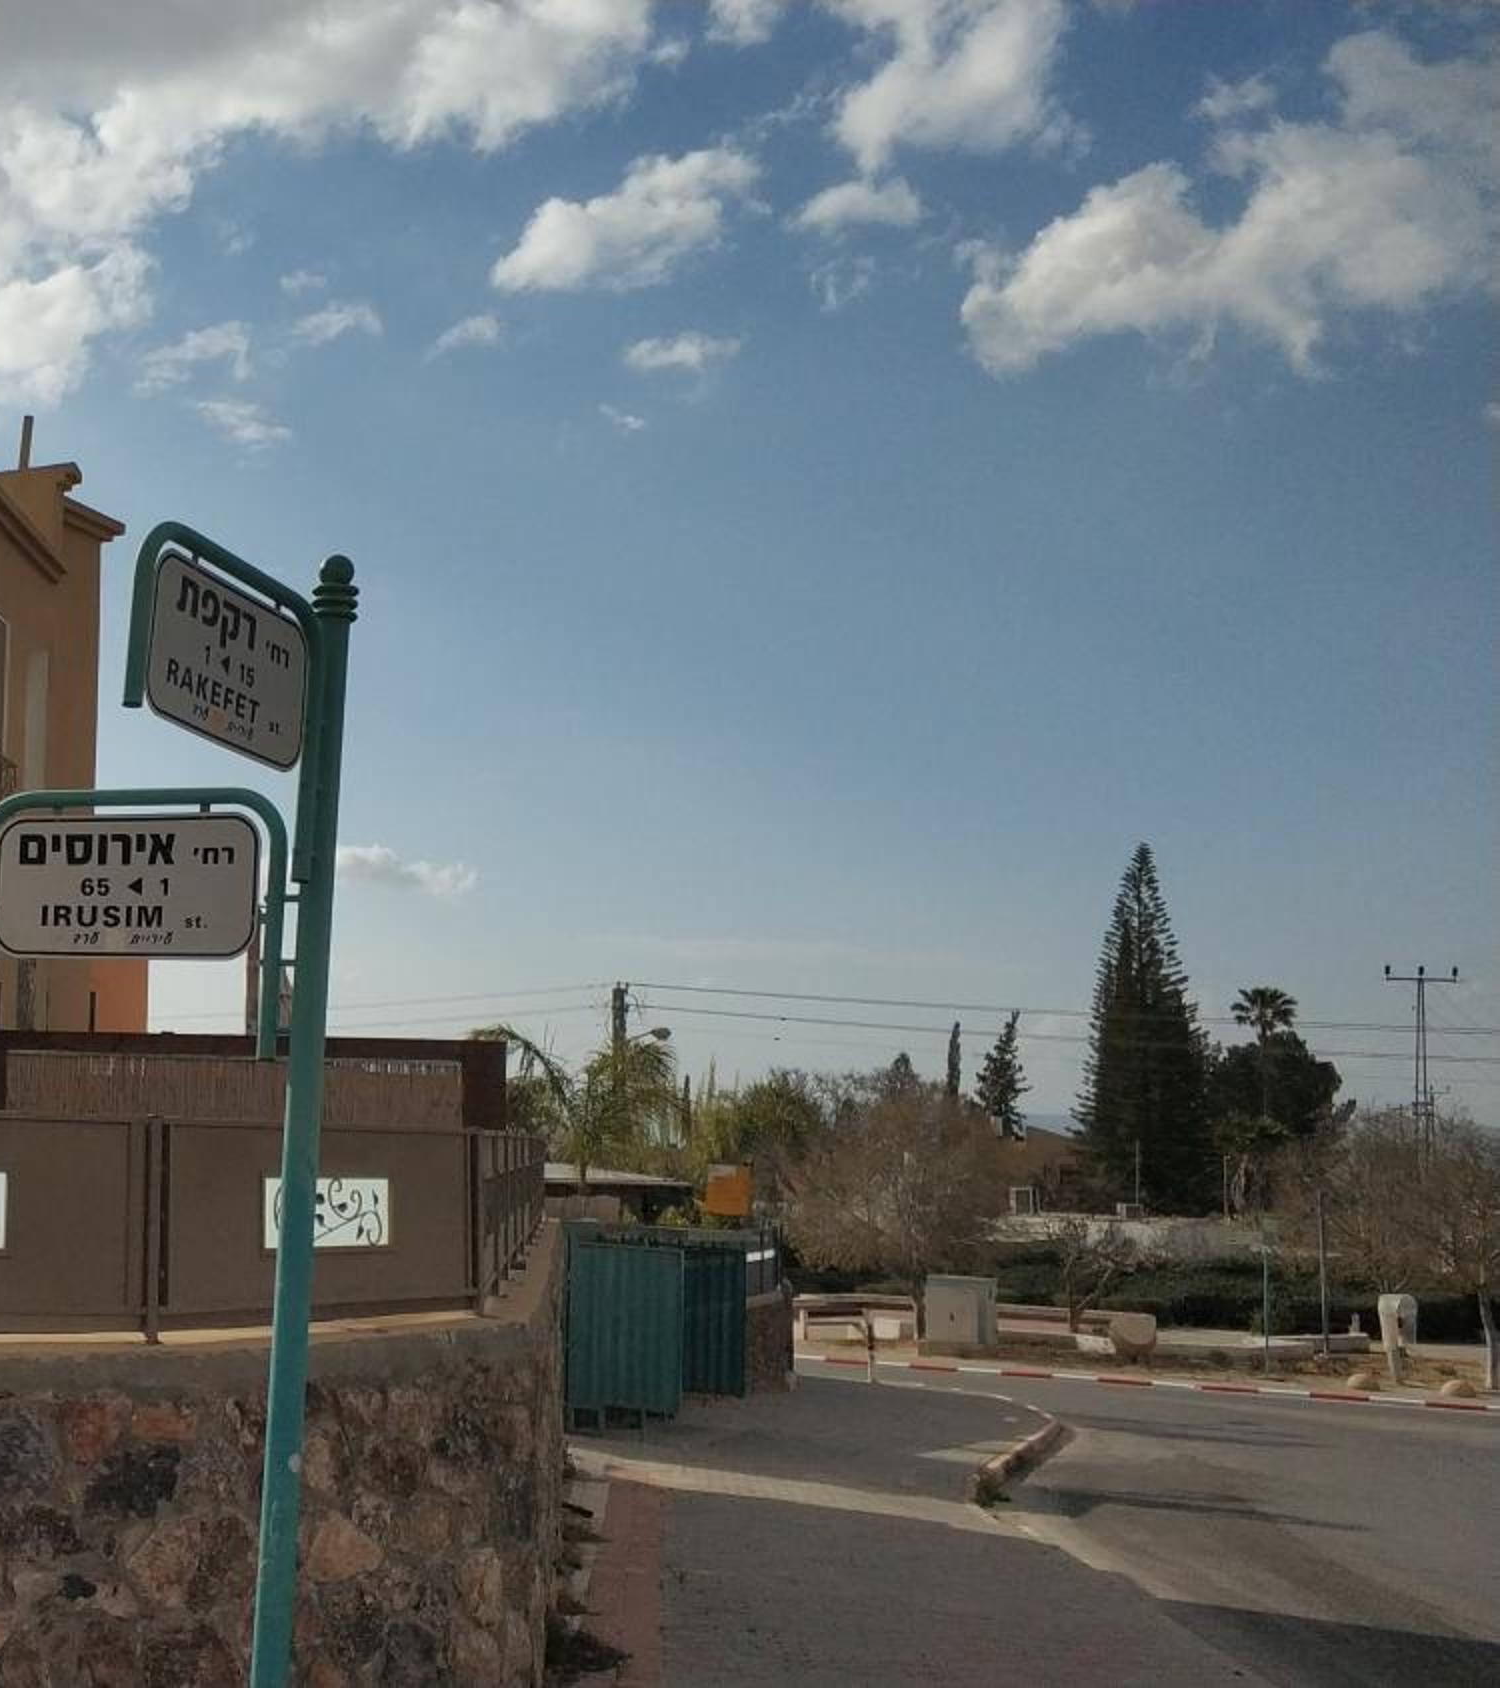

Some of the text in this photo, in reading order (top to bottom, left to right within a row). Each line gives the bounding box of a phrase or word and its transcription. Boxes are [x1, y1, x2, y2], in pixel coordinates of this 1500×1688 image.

[176, 575, 258, 652] רקפת
[204, 645, 256, 689] 1 15
[166, 657, 261, 725] RAKEFET
[18, 833, 176, 866] אירוסים
[80, 877, 170, 897] 65 1
[40, 904, 209, 929] IRUSIM st.
